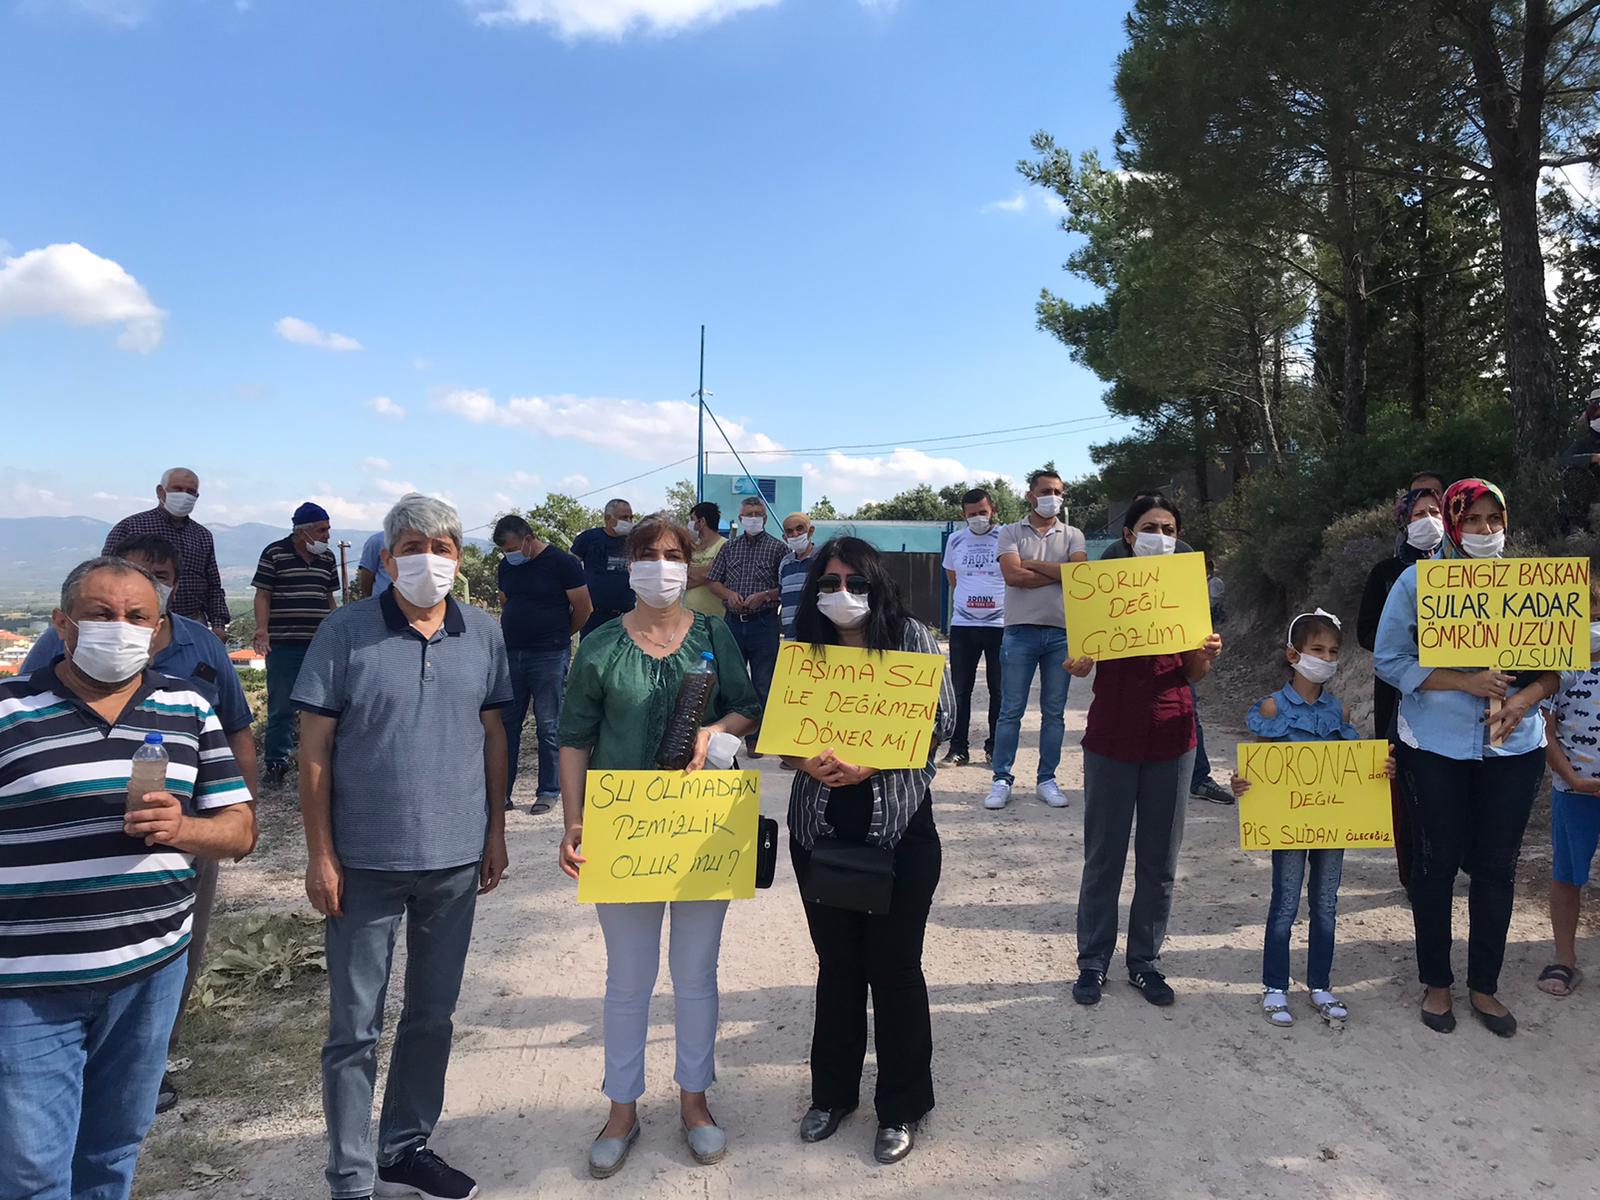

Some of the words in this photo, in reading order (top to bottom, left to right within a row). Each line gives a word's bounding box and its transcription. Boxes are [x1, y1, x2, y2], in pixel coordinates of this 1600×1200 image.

[1069, 563, 1160, 600] SORUN
[1426, 561, 1511, 589] CENGİZ
[1519, 560, 1588, 587] BAŞKAN
[1108, 589, 1179, 618] DEĞİL
[1420, 592, 1490, 620] SULAR
[1502, 592, 1583, 619] KADAR
[1421, 621, 1499, 649] ÖMRÜN
[783, 644, 875, 684] TAŞIMA
[884, 664, 937, 688] SU
[783, 685, 813, 705] İLE
[824, 691, 935, 721] DEĞİRMEN
[793, 717, 873, 747] DÖNER
[592, 773, 635, 809] SU
[646, 776, 758, 801] OLMADAN
[1290, 791, 1344, 809] DEĞİL
[612, 809, 735, 840] TEMİZLİK
[1242, 822, 1271, 846] PİS
[610, 853, 679, 879] OLUR
